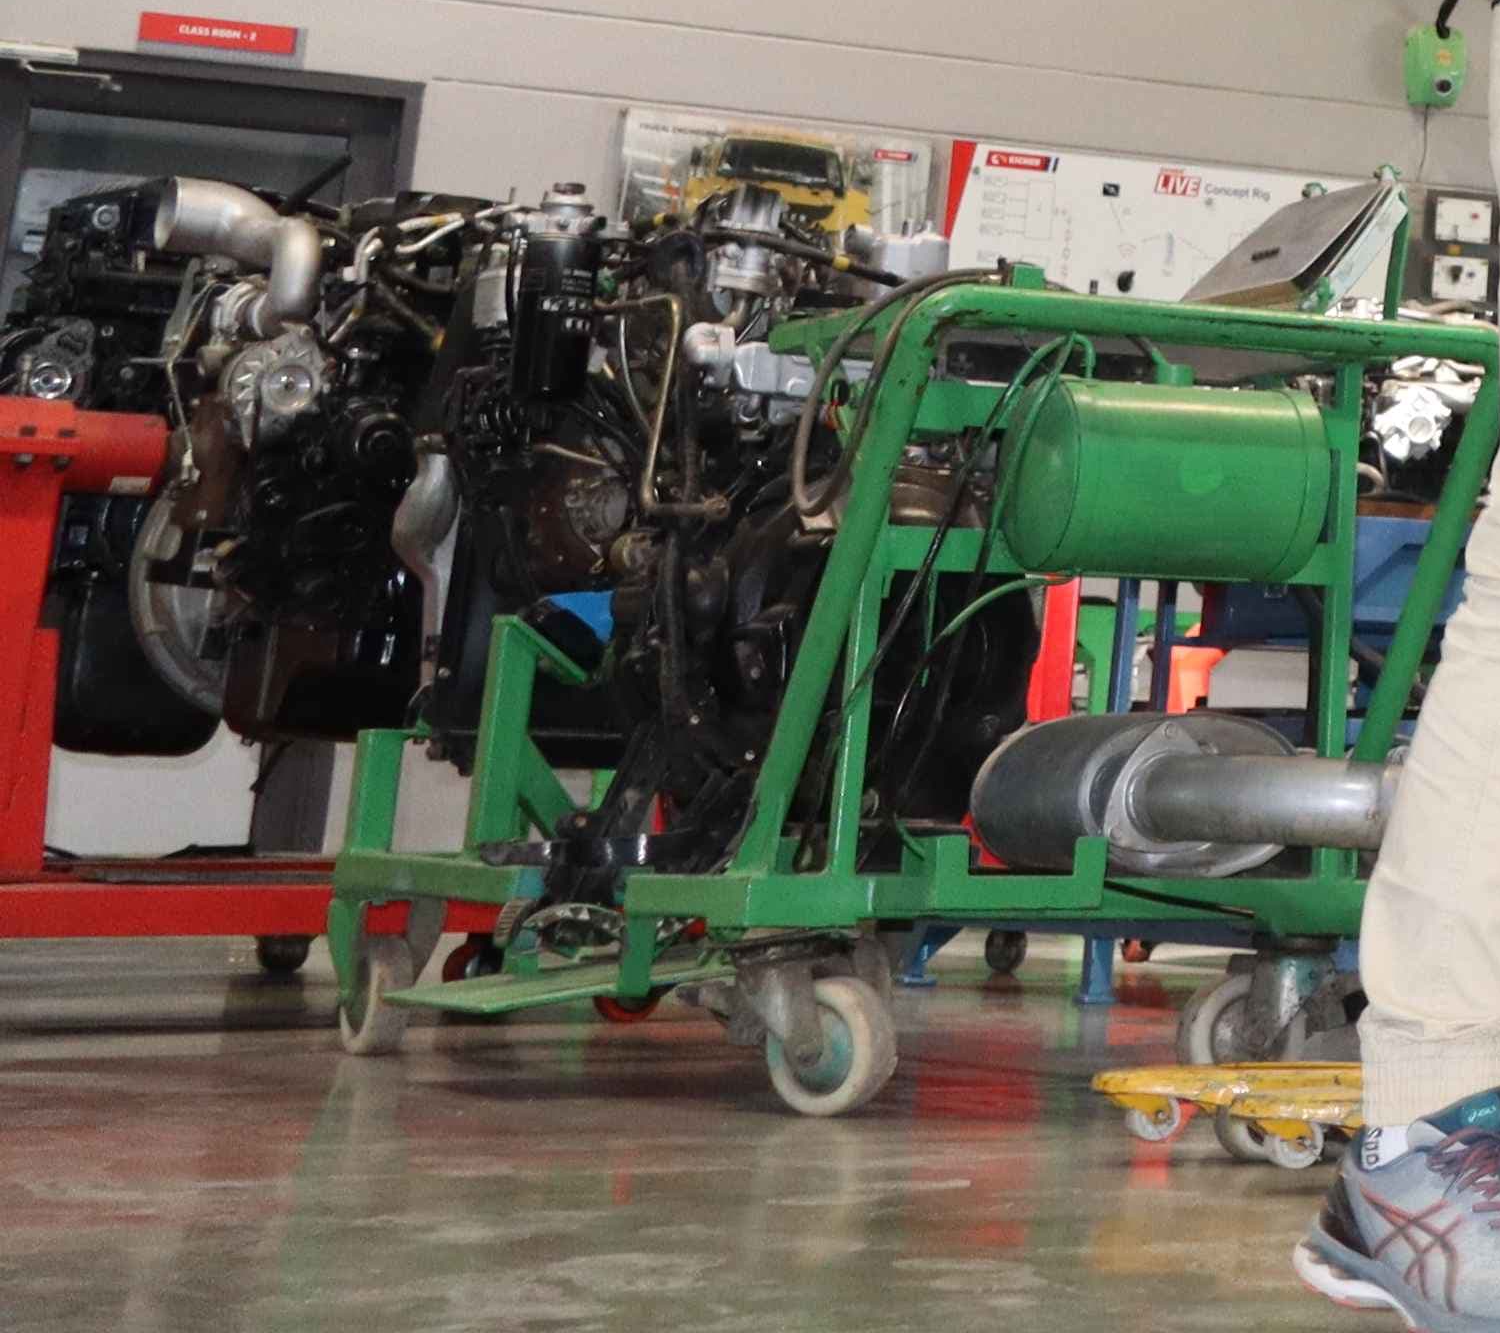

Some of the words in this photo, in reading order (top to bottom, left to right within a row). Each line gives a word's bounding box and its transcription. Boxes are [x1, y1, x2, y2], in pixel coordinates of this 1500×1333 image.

[178, 24, 209, 37] CLASS
[1156, 172, 1200, 198] LIVE
[1204, 183, 1250, 199] Concept
[1252, 187, 1271, 202] Rig
